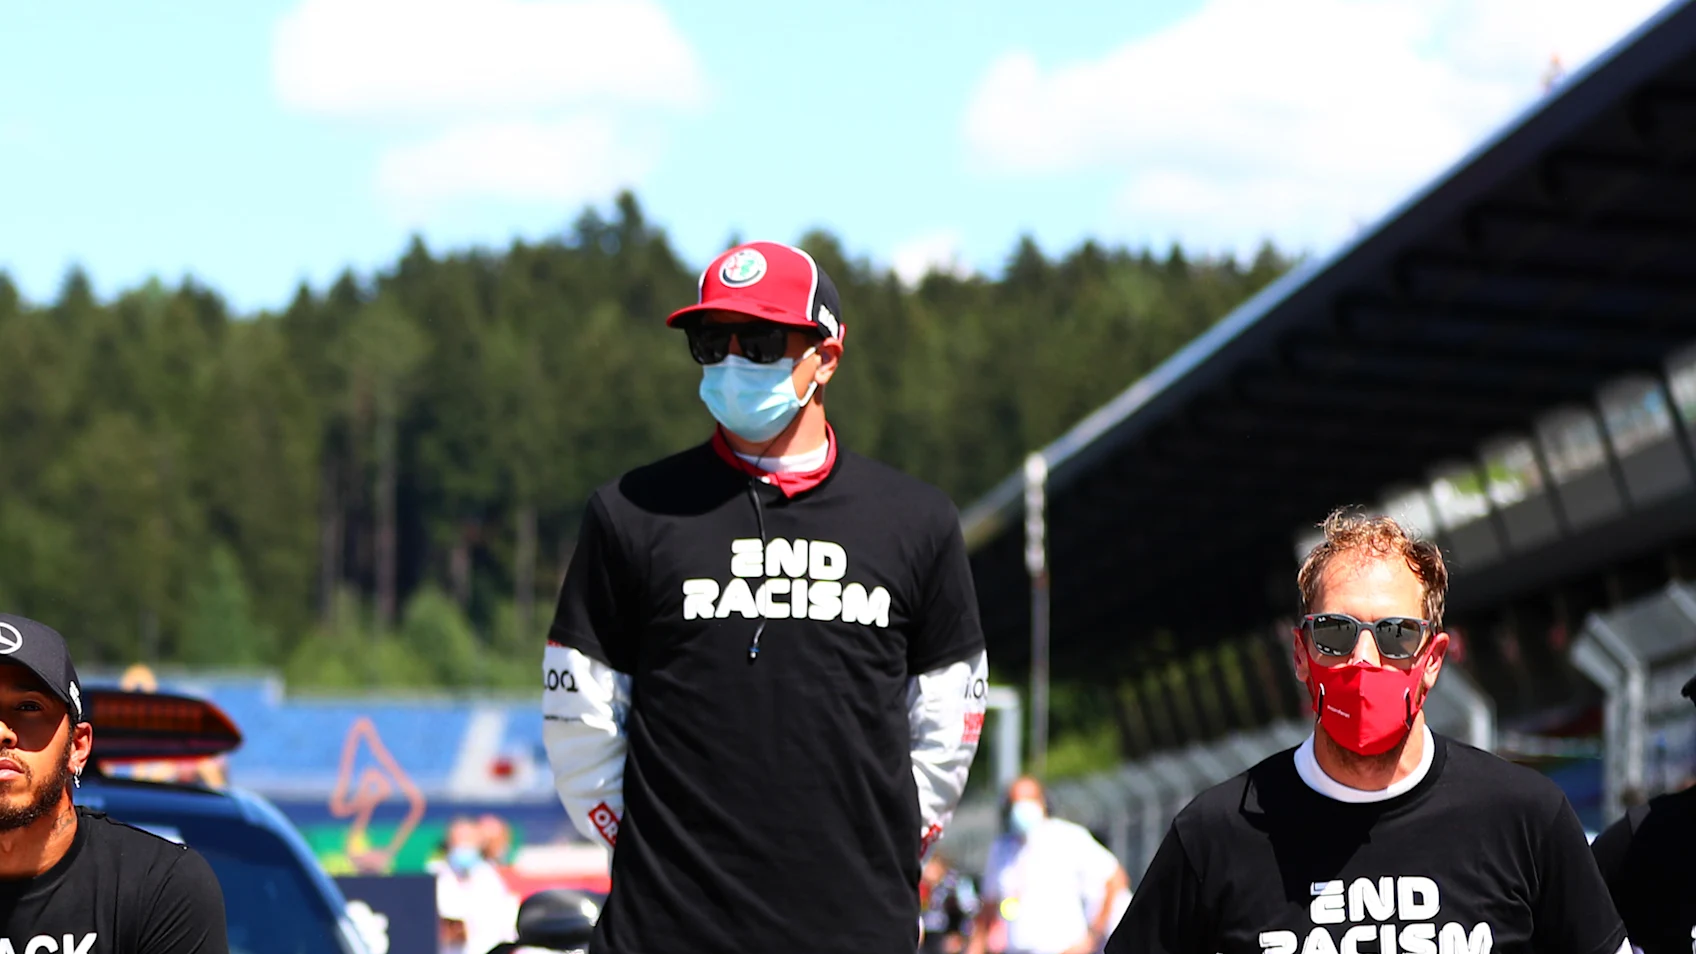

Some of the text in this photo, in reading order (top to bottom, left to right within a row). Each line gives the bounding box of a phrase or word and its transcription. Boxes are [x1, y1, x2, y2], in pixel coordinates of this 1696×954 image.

[731, 538, 848, 580] END
[682, 578, 892, 628] RACISM
[1310, 875, 1441, 925] END
